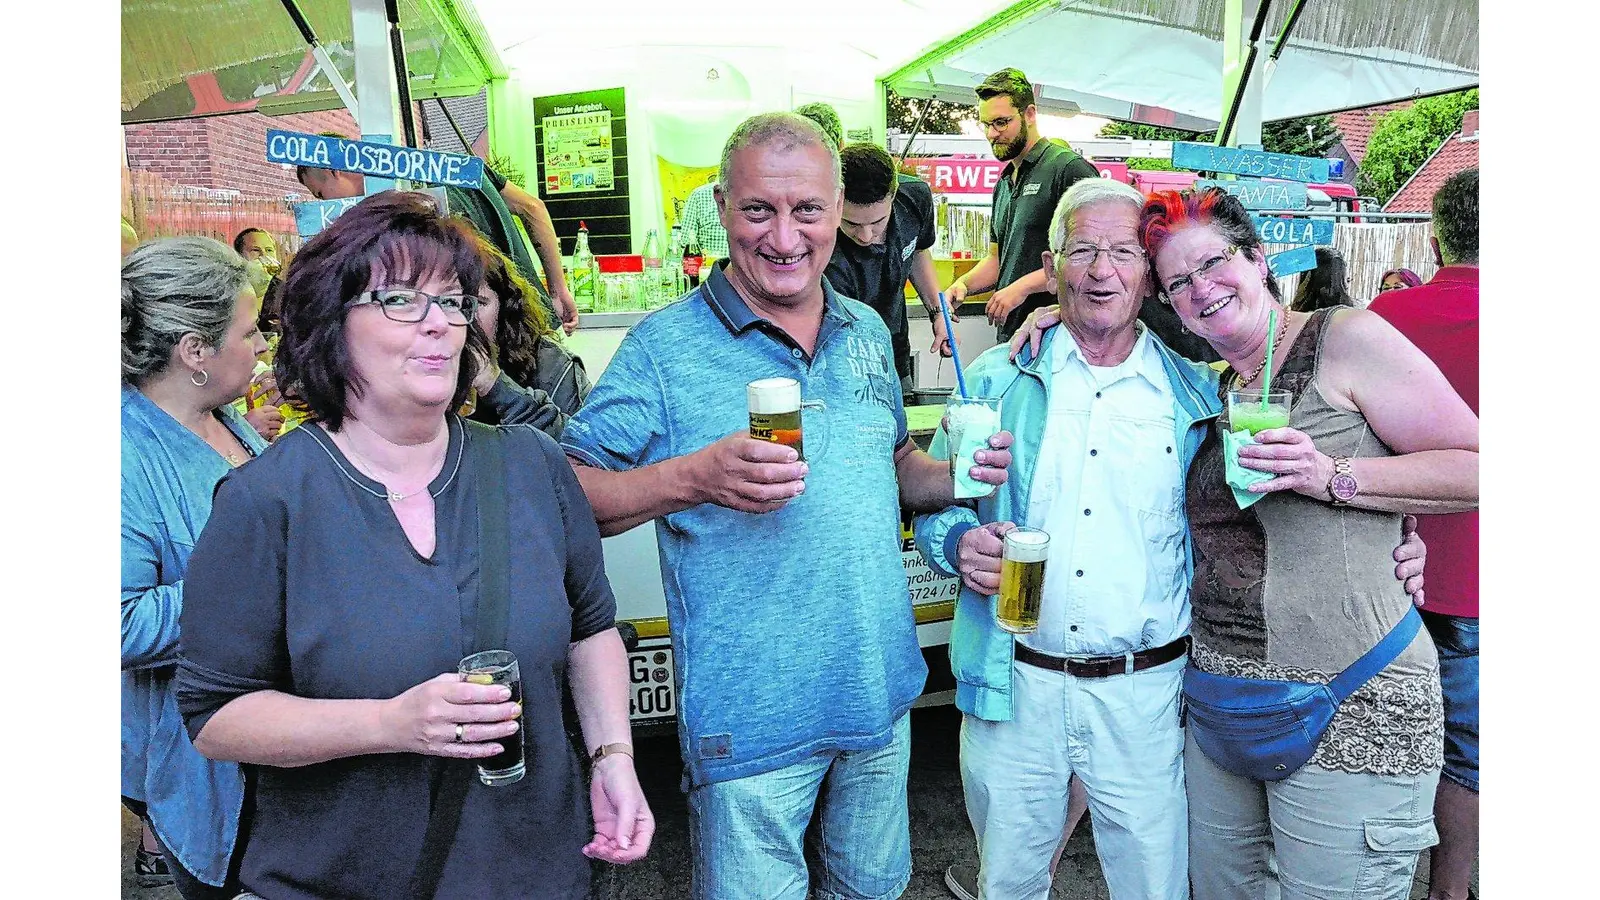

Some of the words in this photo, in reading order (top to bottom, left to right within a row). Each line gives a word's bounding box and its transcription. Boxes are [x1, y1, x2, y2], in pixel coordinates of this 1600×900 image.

[545, 115, 608, 128] PREISLISTE
[270, 135, 331, 165] COLA
[1208, 149, 1313, 180] WASSER
[916, 165, 1000, 188] ERWE
[1260, 220, 1314, 243] COLA
